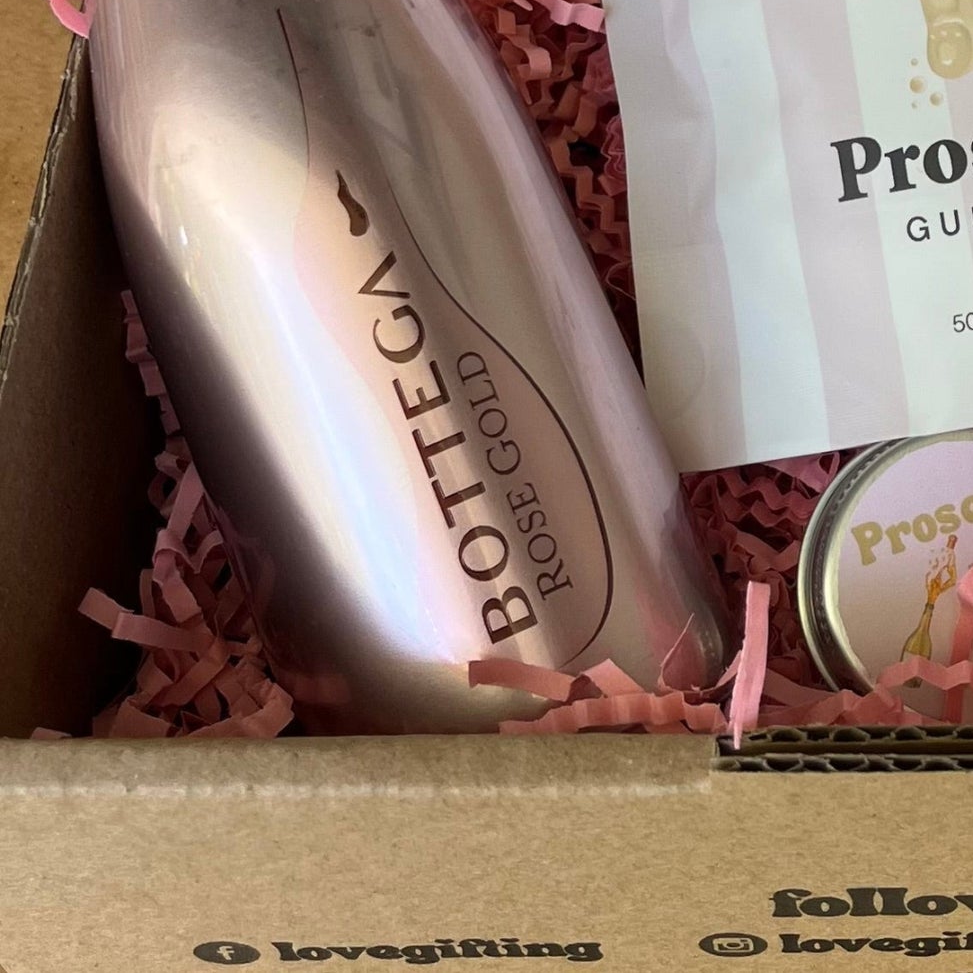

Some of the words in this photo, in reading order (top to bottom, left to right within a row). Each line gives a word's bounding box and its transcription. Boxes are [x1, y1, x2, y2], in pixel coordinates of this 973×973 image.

[358, 250, 539, 644] BOTTEGA
[456, 351, 522, 476] GOLD
[506, 482, 574, 601] ROSE
[272, 938, 604, 965] lovegifting
